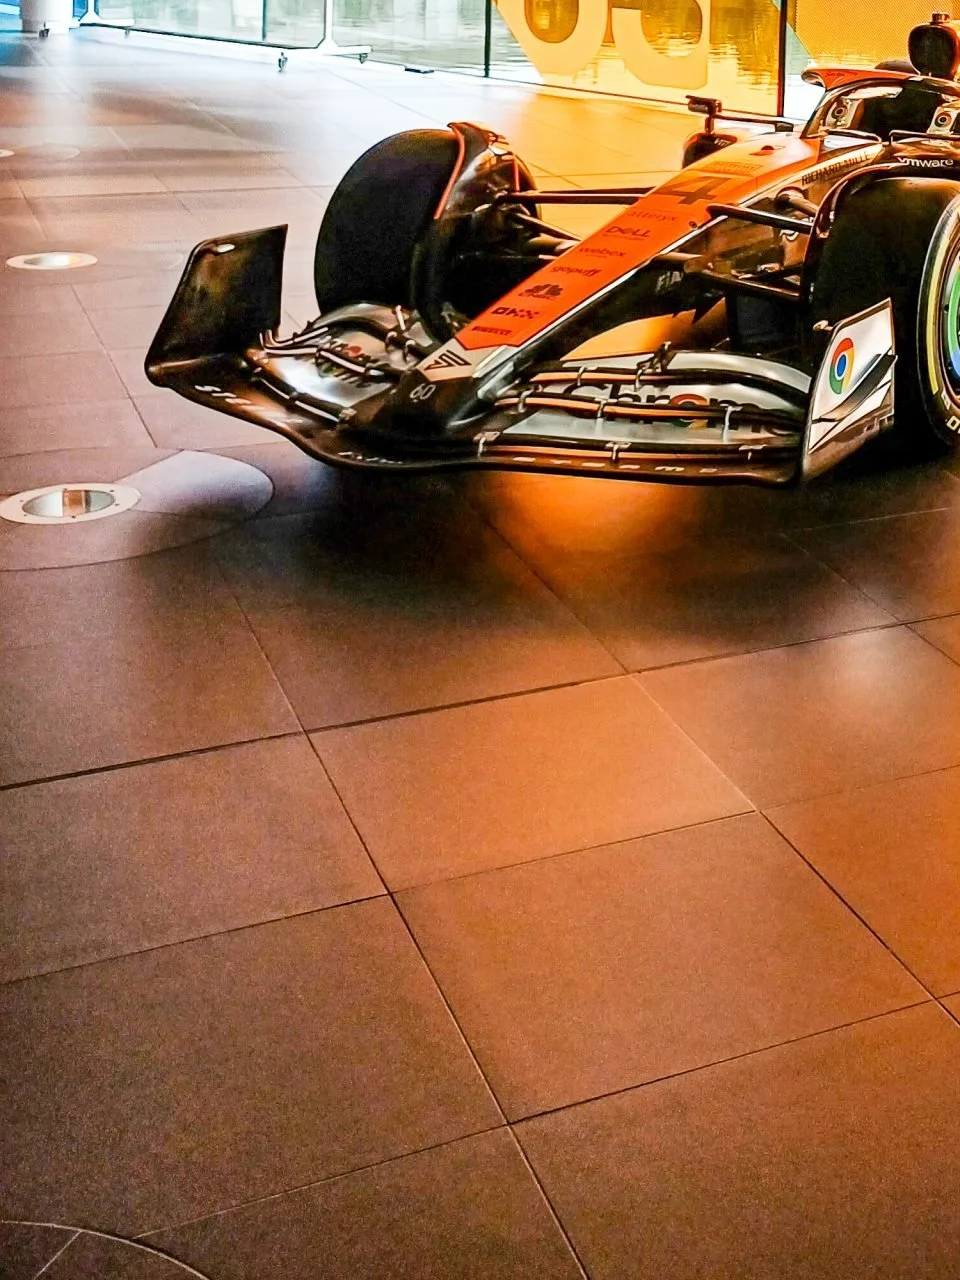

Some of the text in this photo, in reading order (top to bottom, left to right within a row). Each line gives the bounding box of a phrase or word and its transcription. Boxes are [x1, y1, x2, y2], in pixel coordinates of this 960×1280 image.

[897, 157, 954, 168] vmware
[654, 176, 732, 205] 4
[606, 226, 651, 238] DELL
[552, 265, 602, 277] gopuff
[410, 383, 436, 400] 60
